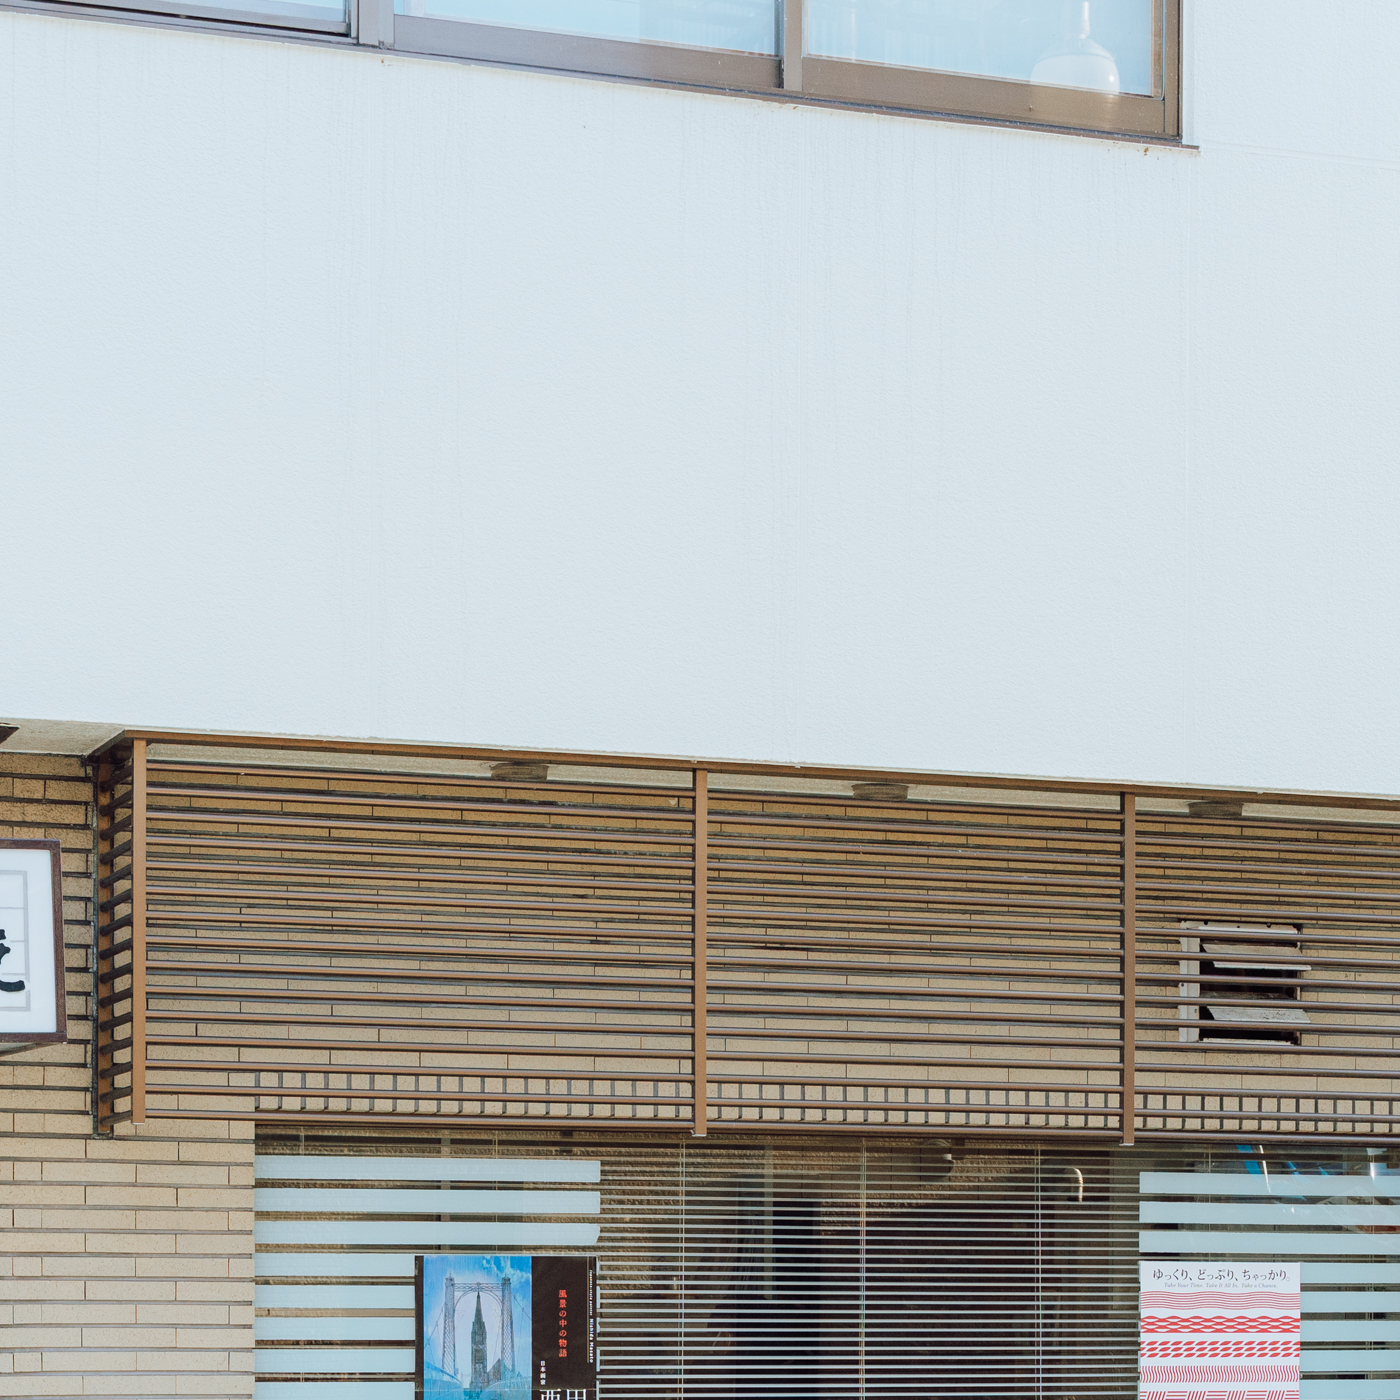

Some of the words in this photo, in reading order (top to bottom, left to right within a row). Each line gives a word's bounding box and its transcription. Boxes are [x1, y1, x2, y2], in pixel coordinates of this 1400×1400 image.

[1152, 1268, 1291, 1282] ゆっくり、どっぷり、ちゃっかり。
[558, 1289, 568, 1358] 風景の中の物語
